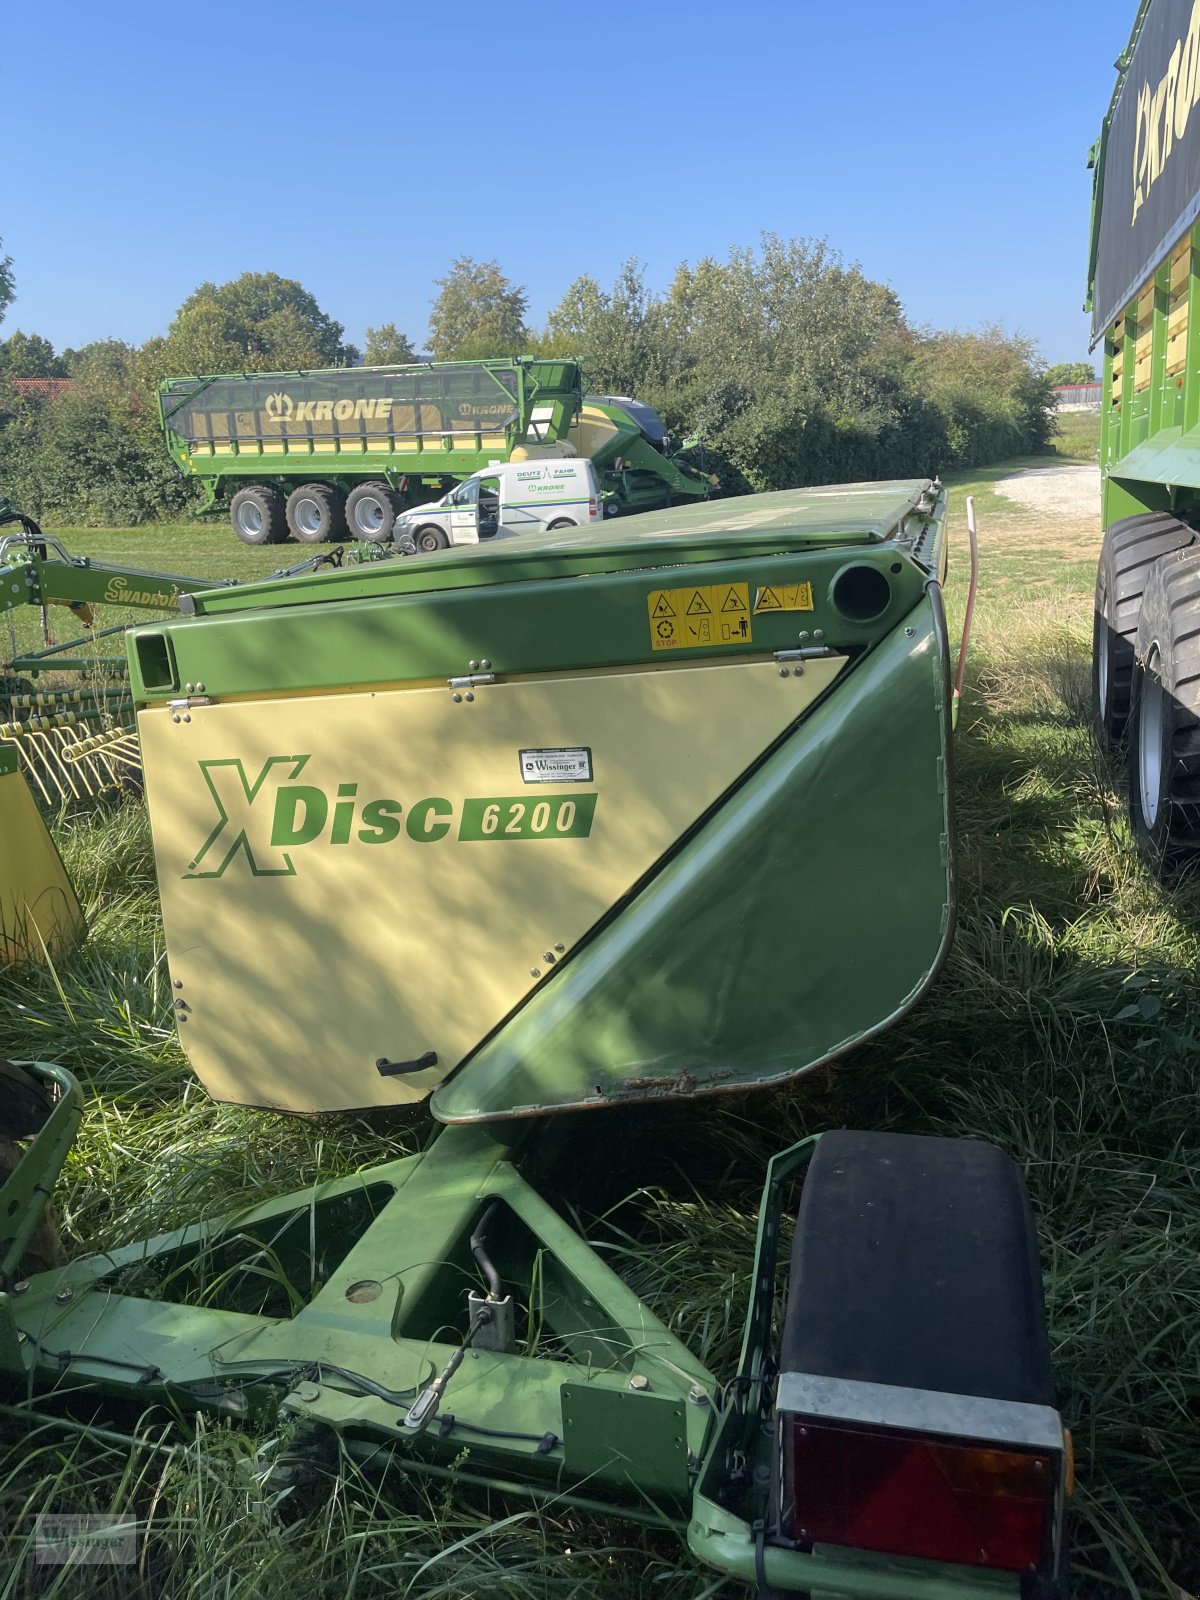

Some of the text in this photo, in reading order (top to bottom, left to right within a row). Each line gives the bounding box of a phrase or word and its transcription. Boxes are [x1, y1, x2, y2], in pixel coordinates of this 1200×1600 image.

[1147, 0, 1200, 198] KRO
[296, 398, 393, 422] KRONE
[472, 404, 514, 415] KRONE
[656, 639, 677, 647] STOP
[535, 760, 576, 771] Wissinger
[481, 801, 576, 834] 6200
